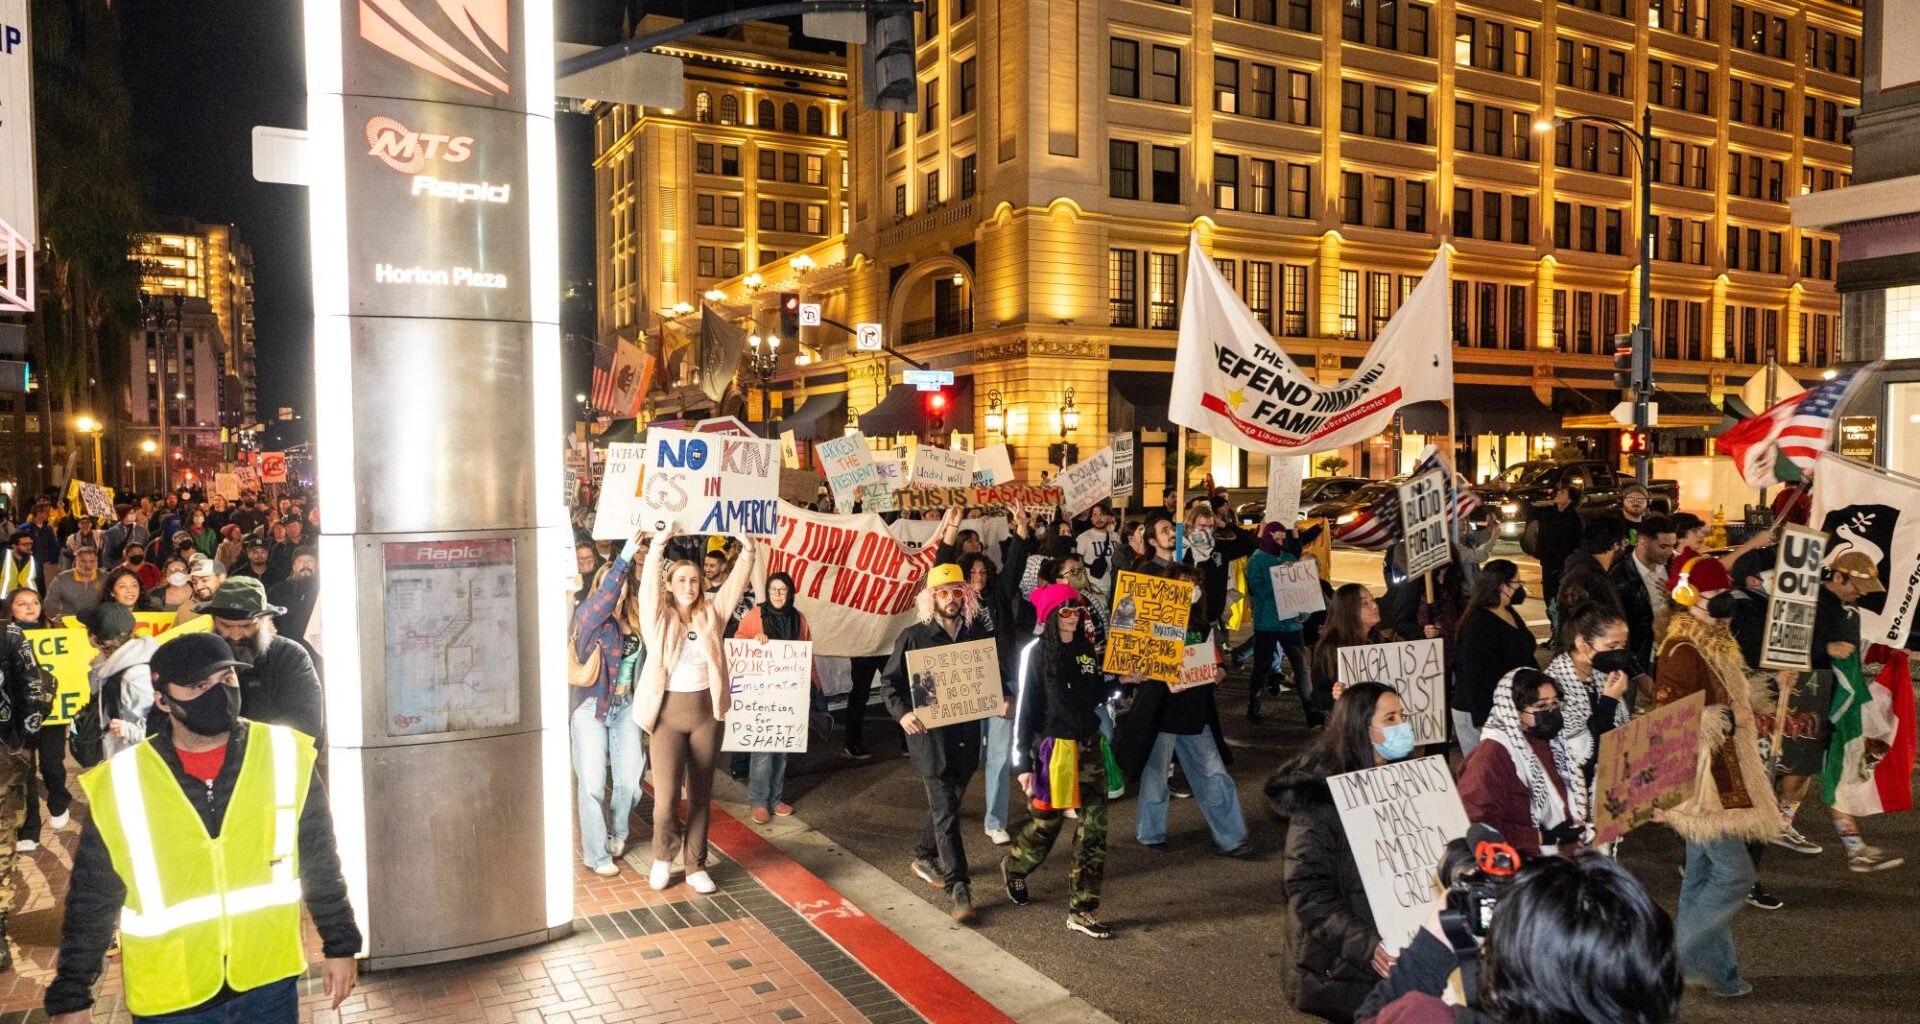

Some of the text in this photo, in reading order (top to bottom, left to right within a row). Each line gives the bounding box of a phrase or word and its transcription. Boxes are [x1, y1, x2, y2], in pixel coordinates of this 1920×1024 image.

[368, 131, 474, 163] MTS
[411, 175, 511, 204] Rapid
[375, 263, 507, 288] Horton Plaza
[1214, 341, 1312, 406] EFEND
[822, 435, 860, 460] ARREST
[1637, 433, 1646, 450] 5
[657, 439, 708, 471] NO
[837, 456, 860, 471] THE
[921, 449, 940, 461] The
[611, 463, 626, 474] TO
[831, 463, 876, 493] PRESIDENT
[704, 476, 722, 497] IN
[863, 482, 892, 498] AZI
[895, 488, 943, 508] THIS
[948, 488, 968, 506] IS
[976, 487, 1060, 506] FASCISM
[699, 500, 778, 534] AMERICA
[415, 546, 484, 561] Rapid
[797, 521, 859, 566] TURN
[855, 532, 905, 579] OUR
[1784, 535, 1820, 572] US
[807, 565, 828, 600] A
[1121, 574, 1149, 598] THE
[1279, 564, 1315, 585] FUCK
[1138, 601, 1189, 627] ICE
[730, 642, 807, 659] When Did
[923, 647, 994, 670] DEPORT
[728, 659, 765, 675] YOUR
[933, 666, 985, 687] HATE
[1341, 642, 1440, 687] MAGA IS A
[946, 682, 982, 700] NOT
[734, 699, 795, 714] Detention
[755, 713, 772, 724] for
[931, 694, 998, 719] FAMILIES
[1334, 756, 1448, 811] IMMIGRANTS
[1373, 796, 1429, 838] MAKE
[1375, 825, 1450, 877] AMERICA
[1392, 867, 1438, 908] GREA
